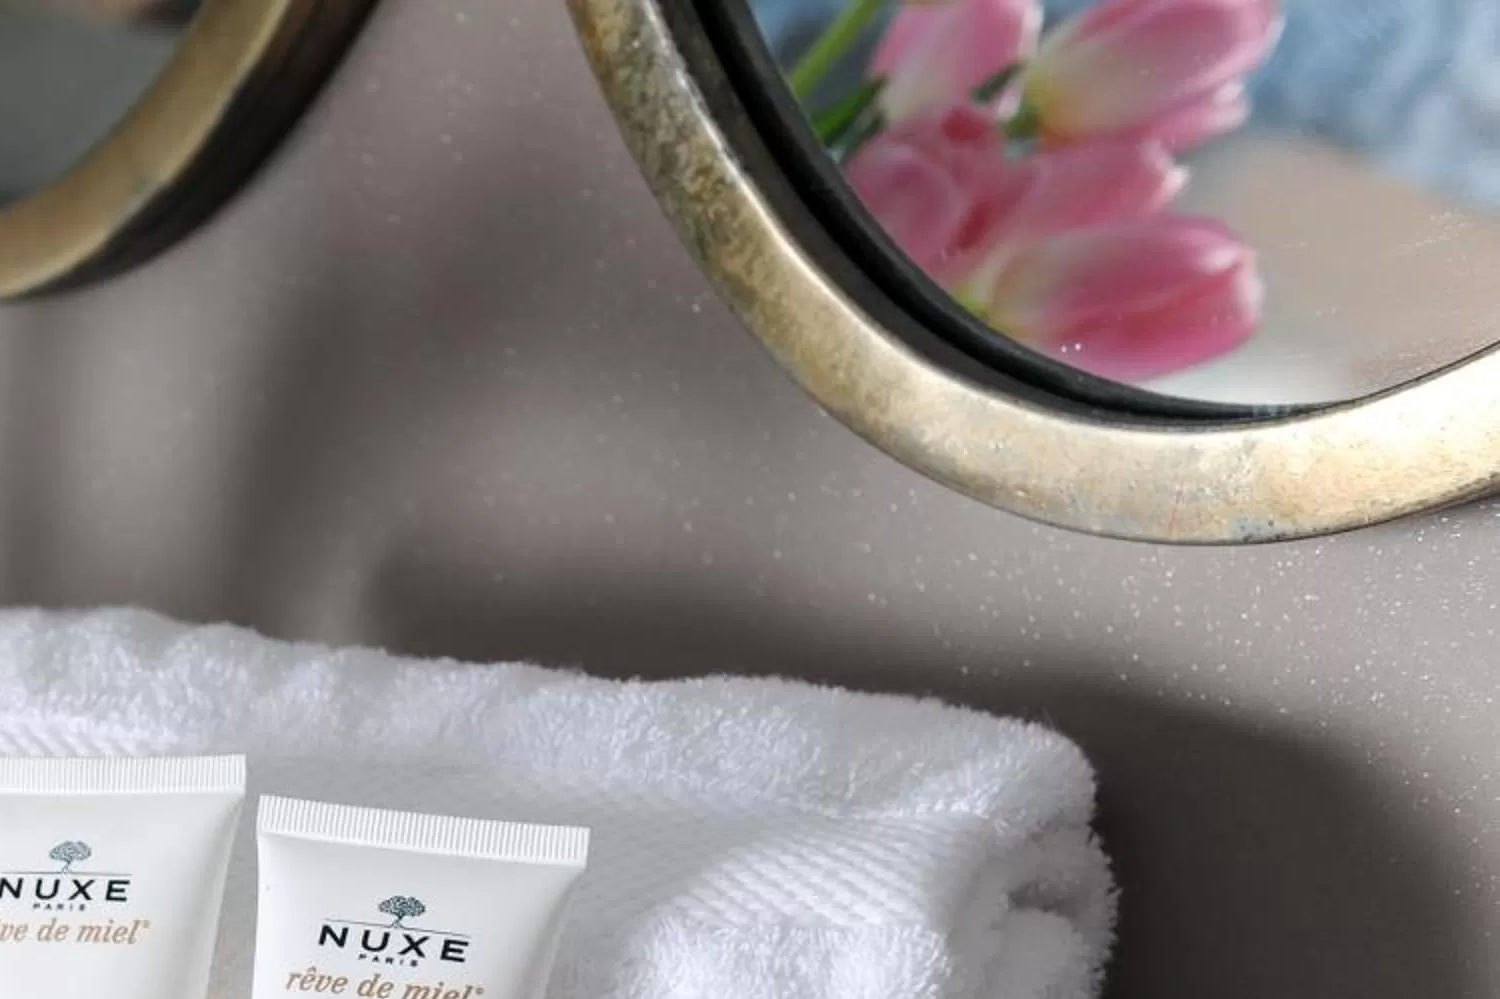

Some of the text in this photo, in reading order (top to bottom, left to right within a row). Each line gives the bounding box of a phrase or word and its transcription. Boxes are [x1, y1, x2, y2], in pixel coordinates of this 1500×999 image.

[33, 903, 85, 911] PARIS
[37, 917, 69, 941] de
[319, 924, 469, 963] NUXE
[358, 953, 419, 967] PARIS
[285, 966, 348, 995] rêve
[357, 973, 394, 999] de
